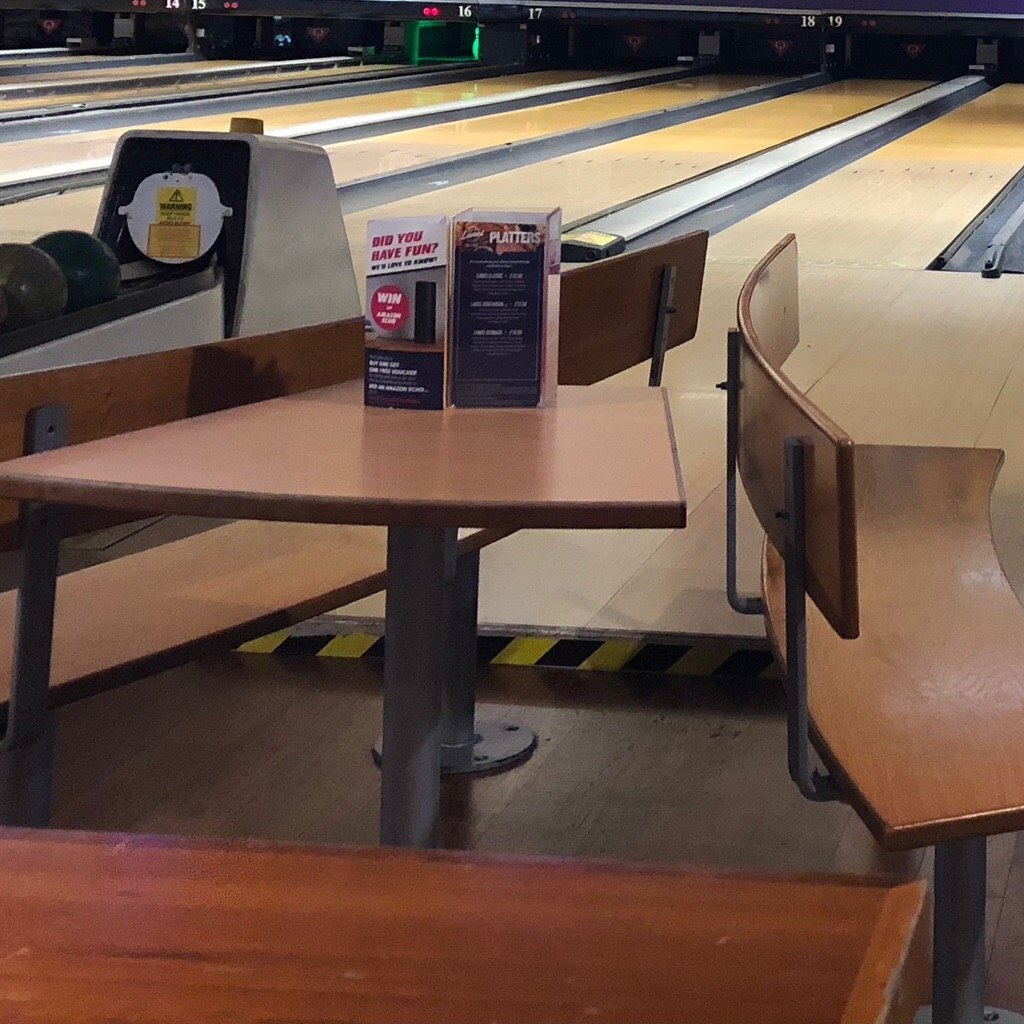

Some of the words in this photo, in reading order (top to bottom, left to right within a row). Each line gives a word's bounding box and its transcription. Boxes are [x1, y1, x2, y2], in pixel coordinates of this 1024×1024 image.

[459, 5, 472, 17] 16
[528, 8, 543, 20] 17
[801, 15, 816, 27] 18
[828, 16, 843, 27] 19
[160, 203, 192, 211] WARNING
[372, 234, 394, 247] DID
[397, 230, 423, 244] YOU
[489, 231, 541, 244] PLATTERS
[371, 247, 402, 261] HAVE
[405, 242, 439, 257] FUN?
[377, 292, 402, 304] WIN
